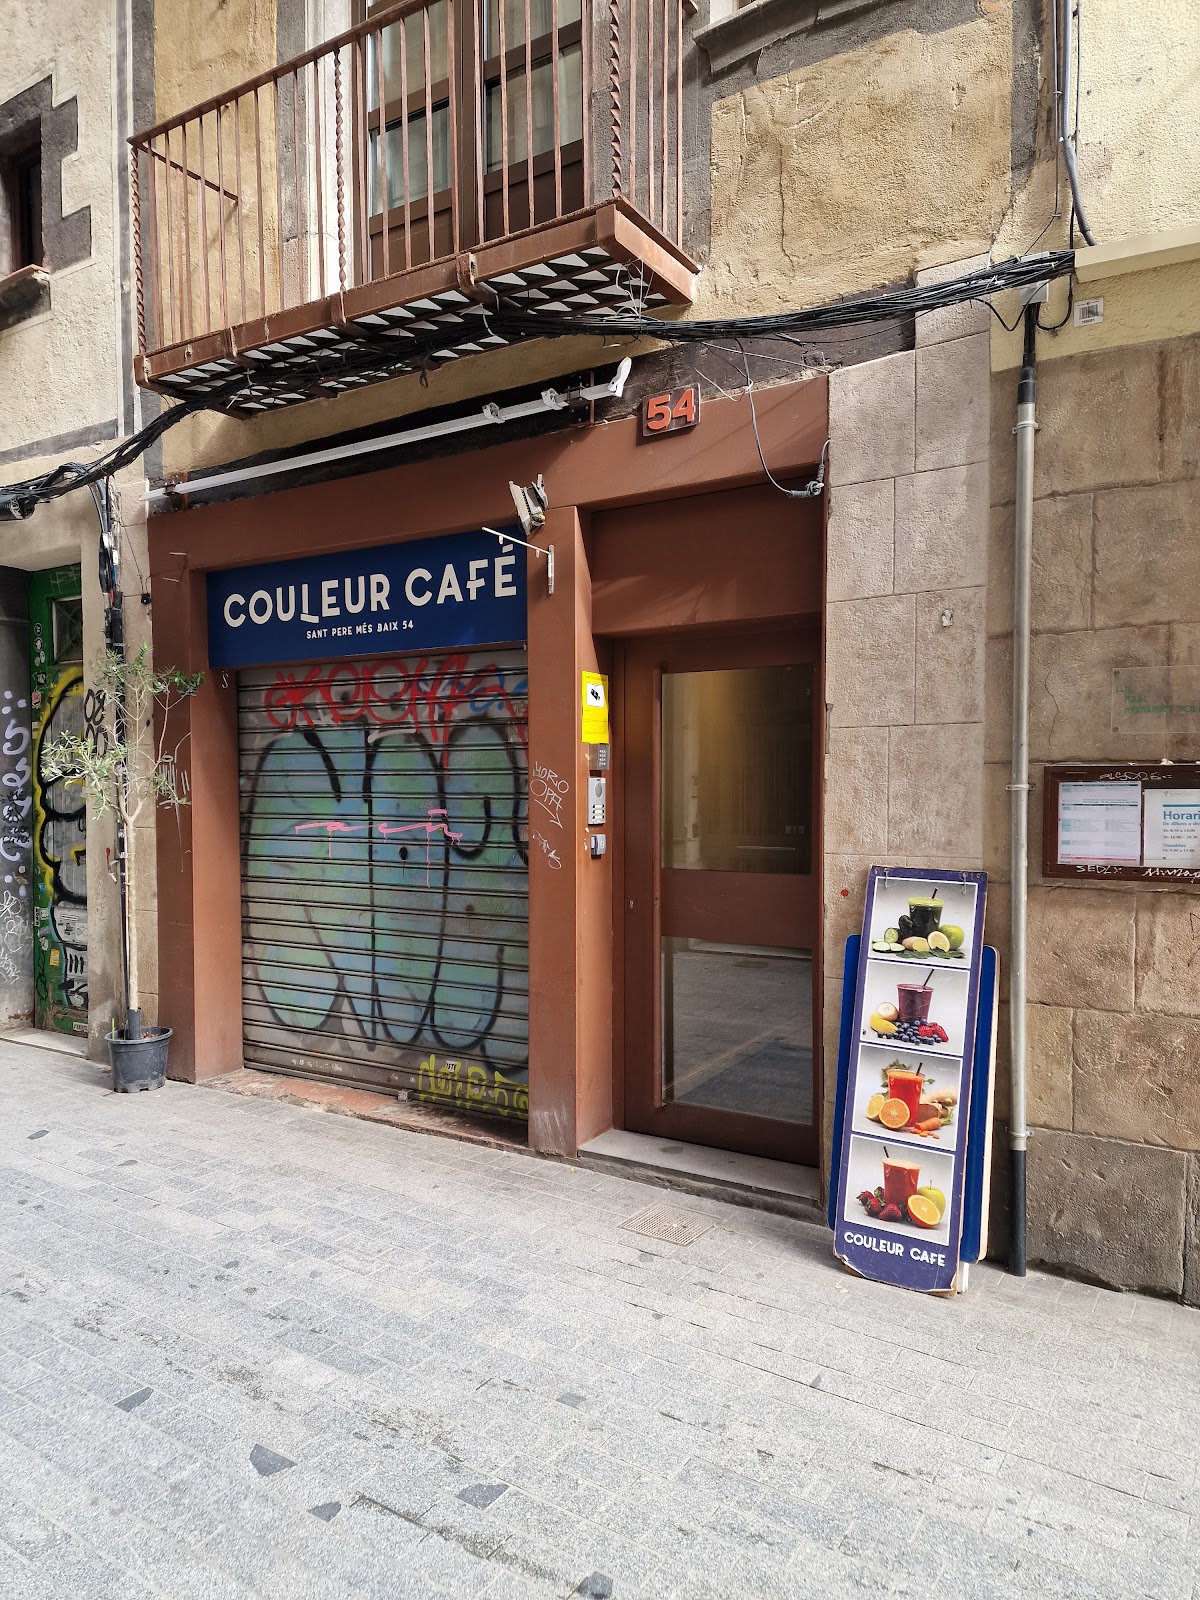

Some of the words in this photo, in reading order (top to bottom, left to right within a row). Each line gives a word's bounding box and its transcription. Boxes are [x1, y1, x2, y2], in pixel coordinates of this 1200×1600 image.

[647, 388, 696, 430] 54
[223, 573, 391, 628] COULEUR
[404, 543, 517, 607] CAFÉ
[306, 629, 328, 639] SANT
[332, 626, 352, 636] PERE
[355, 621, 373, 634] MÉS
[376, 622, 398, 632] BAIX
[402, 620, 414, 630] 54
[844, 1232, 904, 1256] COULEUR
[910, 1248, 946, 1266] CAFE
